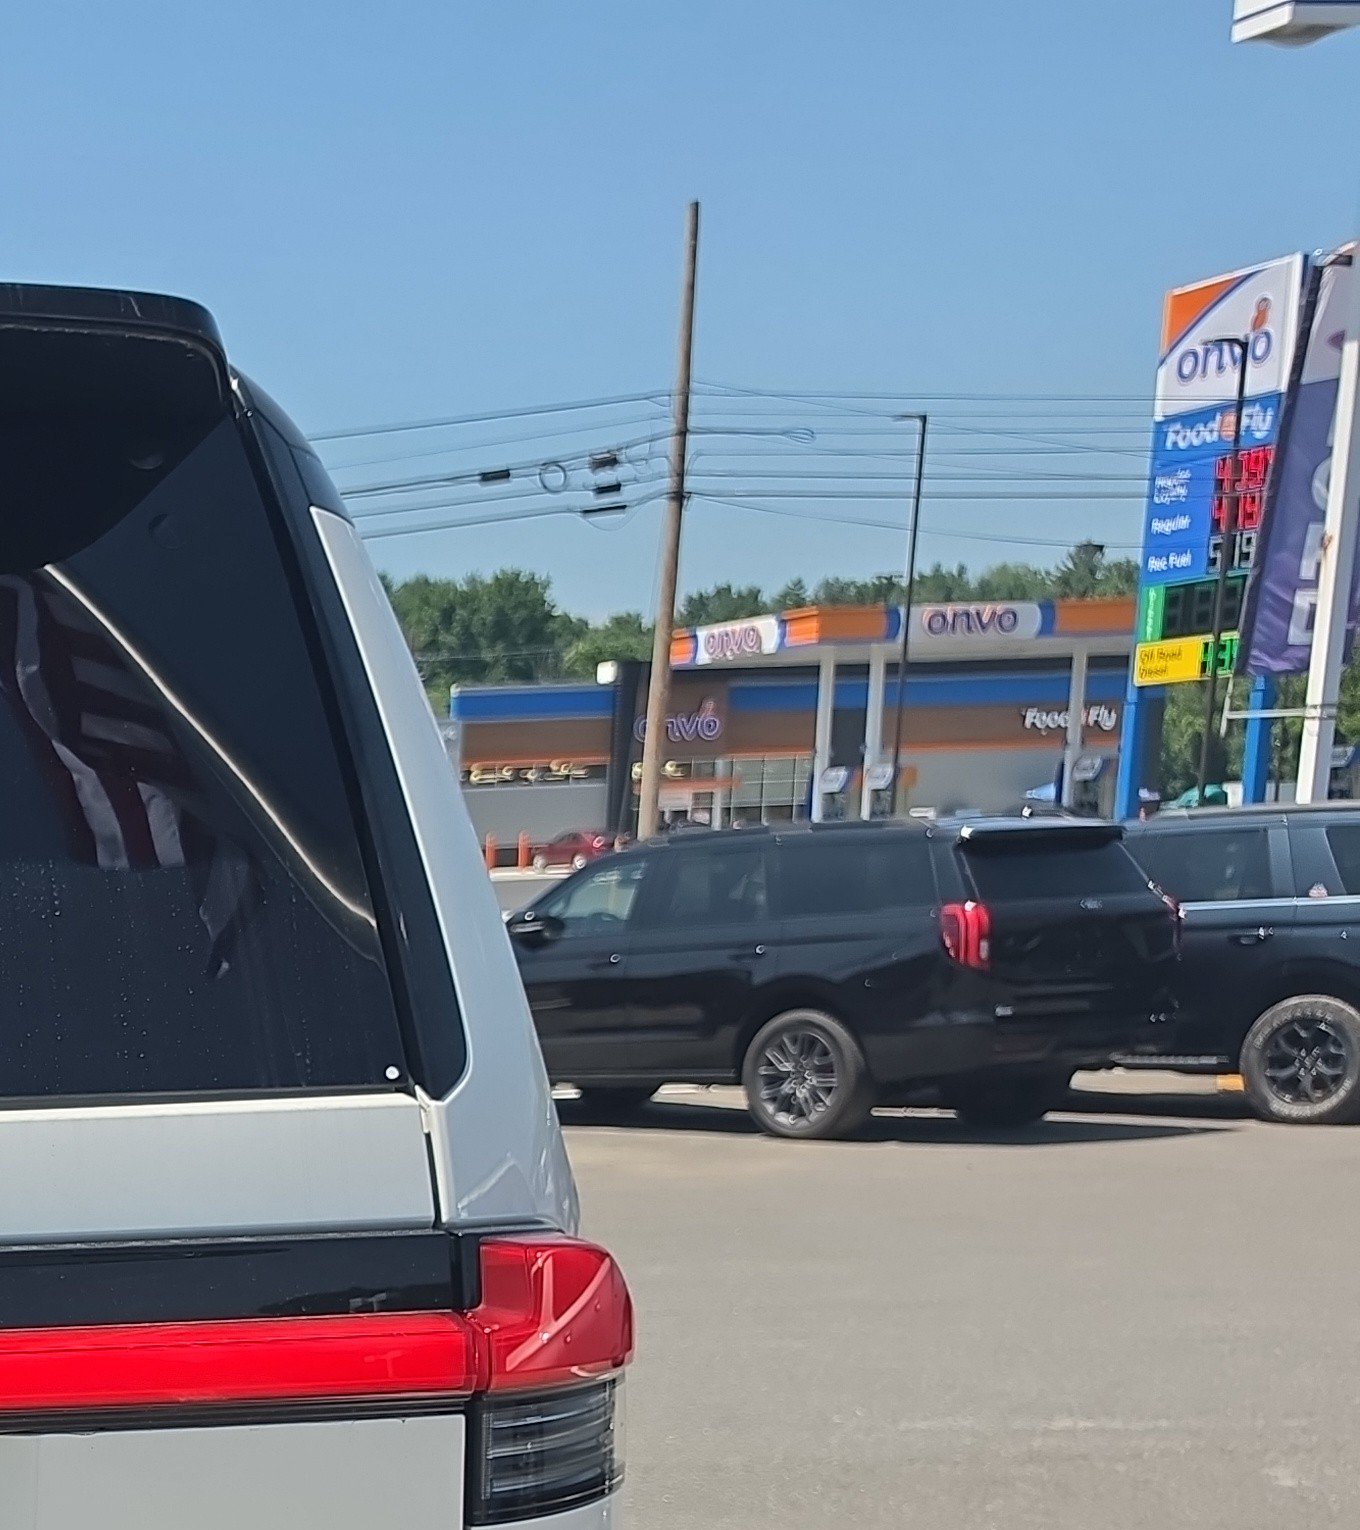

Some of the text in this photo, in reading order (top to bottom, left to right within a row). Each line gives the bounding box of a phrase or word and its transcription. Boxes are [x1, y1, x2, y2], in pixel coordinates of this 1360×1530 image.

[1177, 330, 1272, 382] onvo
[1163, 402, 1275, 450] Food Fly
[923, 606, 1019, 636] onvo
[1087, 704, 1117, 731] Fly
